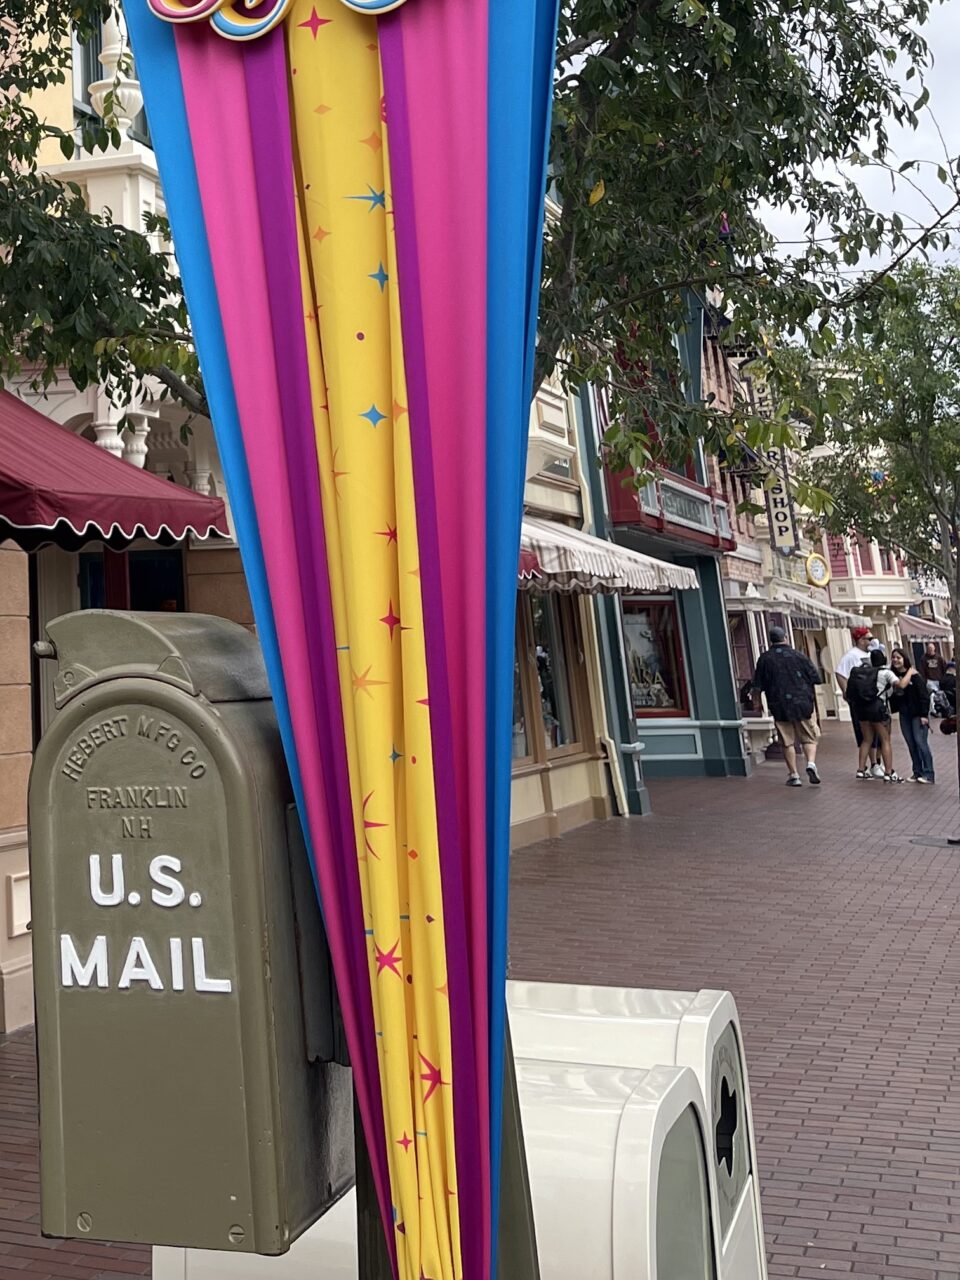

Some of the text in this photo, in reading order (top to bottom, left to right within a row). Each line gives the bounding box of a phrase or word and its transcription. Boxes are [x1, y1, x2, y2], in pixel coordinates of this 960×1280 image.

[770, 483, 790, 537] SHOP
[61, 715, 207, 782] HEBERT MFG CO
[86, 786, 188, 810] FRANKLIN
[89, 853, 202, 908] U.S.
[60, 934, 232, 994] MAIL
